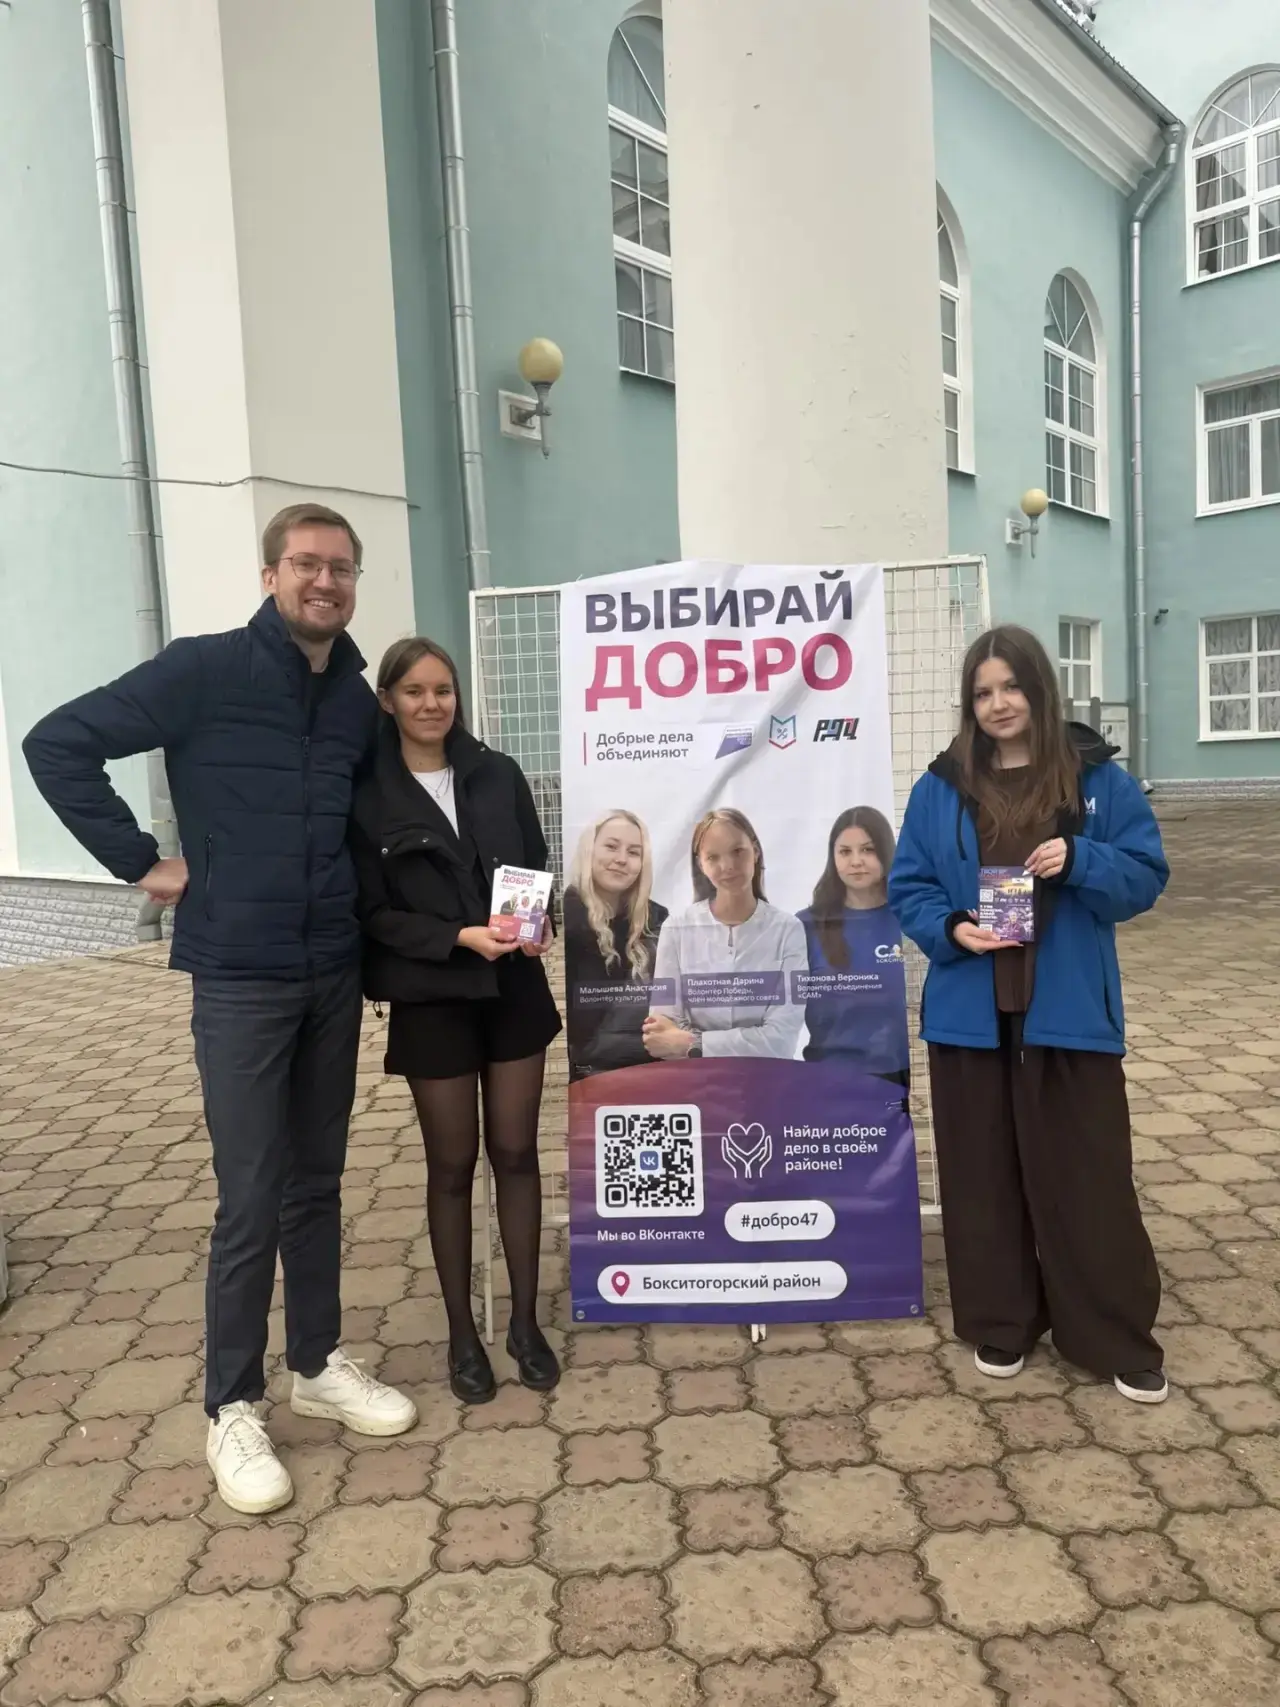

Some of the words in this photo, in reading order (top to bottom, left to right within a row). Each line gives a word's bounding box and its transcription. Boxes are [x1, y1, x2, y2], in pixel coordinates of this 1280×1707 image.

[586, 569, 853, 634] ВЫБИРАЙ
[585, 632, 853, 712] ДОБРО
[596, 732, 655, 748] Добрые
[658, 732, 694, 745] дела
[597, 748, 689, 761] объединяют
[503, 868, 535, 880] ВЫБИРАЙ
[501, 875, 534, 887] ДОБРО
[687, 978, 731, 987] Плахотная
[733, 977, 764, 986] Дарина
[797, 975, 836, 983] Тихонова
[837, 973, 879, 983] Вероника
[579, 985, 624, 995] Малышева
[625, 984, 667, 994] Анастасия
[833, 983, 883, 992] объединения
[615, 994, 647, 1003] культуры
[798, 992, 822, 1000] «САМ»
[783, 1124, 829, 1140] Найди
[832, 1123, 887, 1140] доброе
[784, 1144, 819, 1156] дело
[822, 1144, 831, 1154] в
[834, 1140, 878, 1153] своём
[785, 1158, 843, 1174] районе!
[741, 1213, 818, 1230] #добро47
[597, 1229, 618, 1241] Мы
[621, 1231, 636, 1241] во
[639, 1228, 705, 1241] ВКонтакте
[643, 1275, 768, 1292] Бокситогорский
[773, 1274, 821, 1291] район
